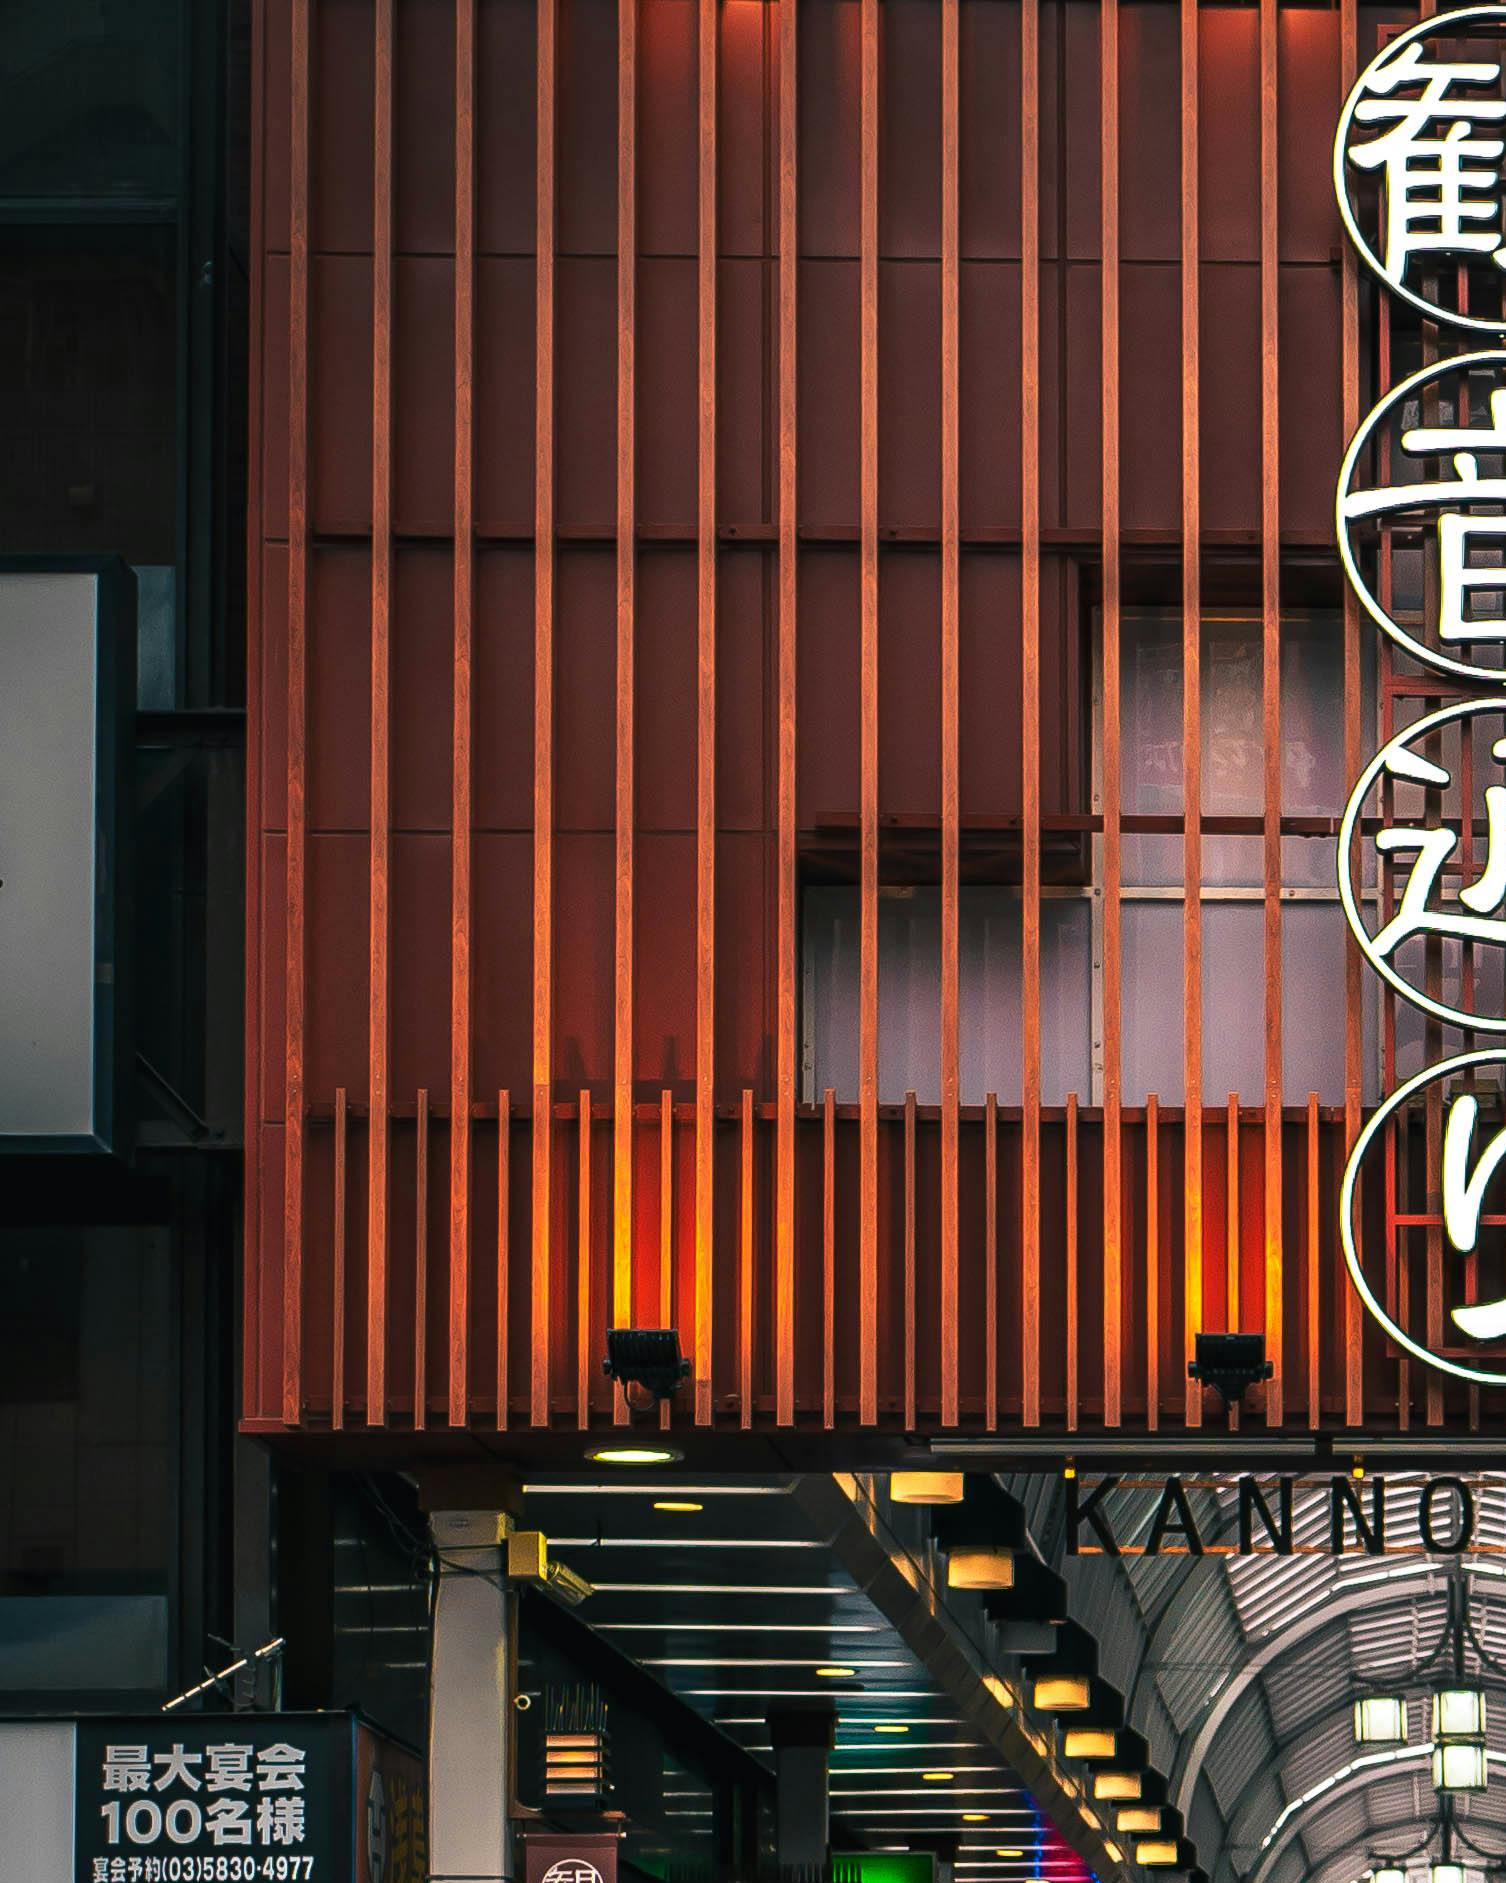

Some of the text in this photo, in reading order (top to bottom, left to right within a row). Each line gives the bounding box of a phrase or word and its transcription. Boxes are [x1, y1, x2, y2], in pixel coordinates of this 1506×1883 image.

[102, 1743, 306, 1793] 最大宴会
[100, 1796, 306, 1846] 100名様
